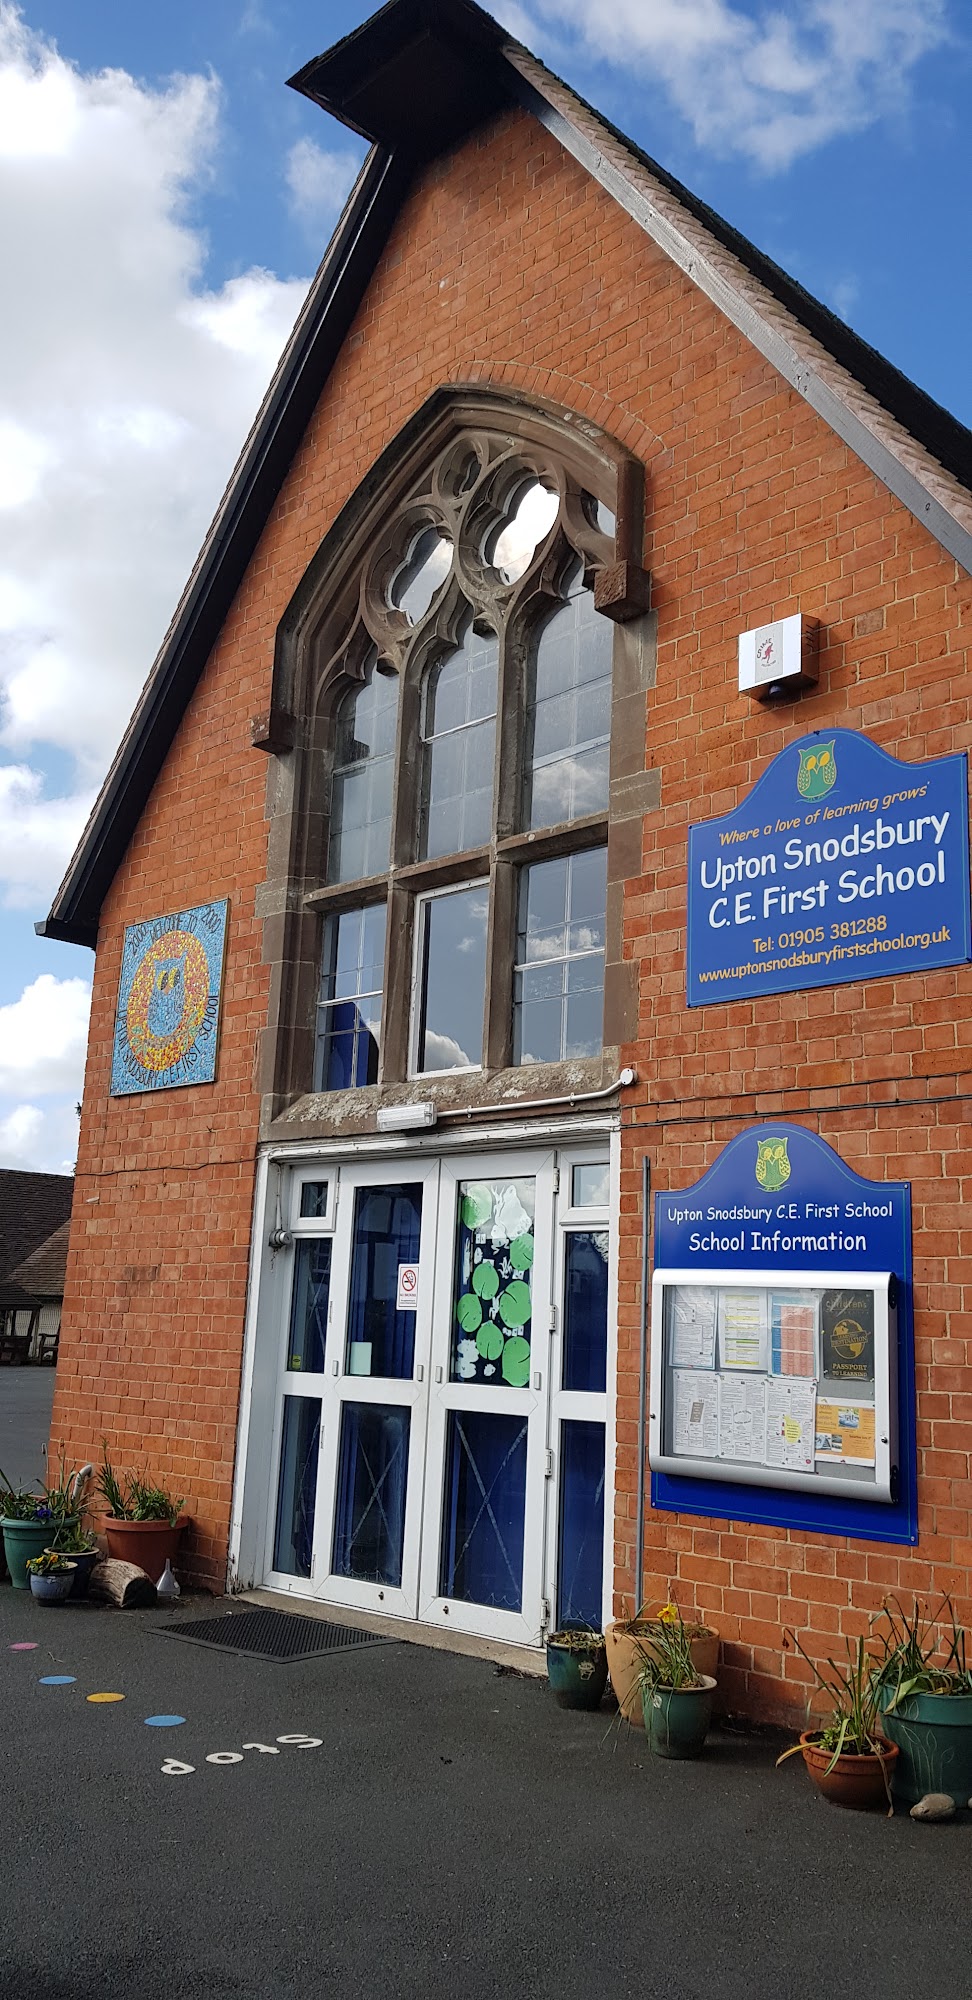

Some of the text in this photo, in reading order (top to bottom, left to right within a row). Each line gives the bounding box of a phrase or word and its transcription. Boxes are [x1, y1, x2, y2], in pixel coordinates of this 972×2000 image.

[764, 825, 772, 836] a
[775, 818, 800, 834] love
[804, 809, 821, 826] of
[823, 797, 879, 821] learning
[701, 811, 950, 891] Upton Snodsbury
[709, 850, 945, 929] C.E. First School
[753, 915, 887, 954] Tel: 01905 381288
[699, 926, 951, 983] www.uptonsnodsburyfirstschool.org.uk
[200, 995, 219, 1041] SCHOOL
[668, 1201, 893, 1224] Upton Snodsbury C.E. First School
[689, 1230, 867, 1252] School Information
[832, 1363, 867, 1371] PASSPORT
